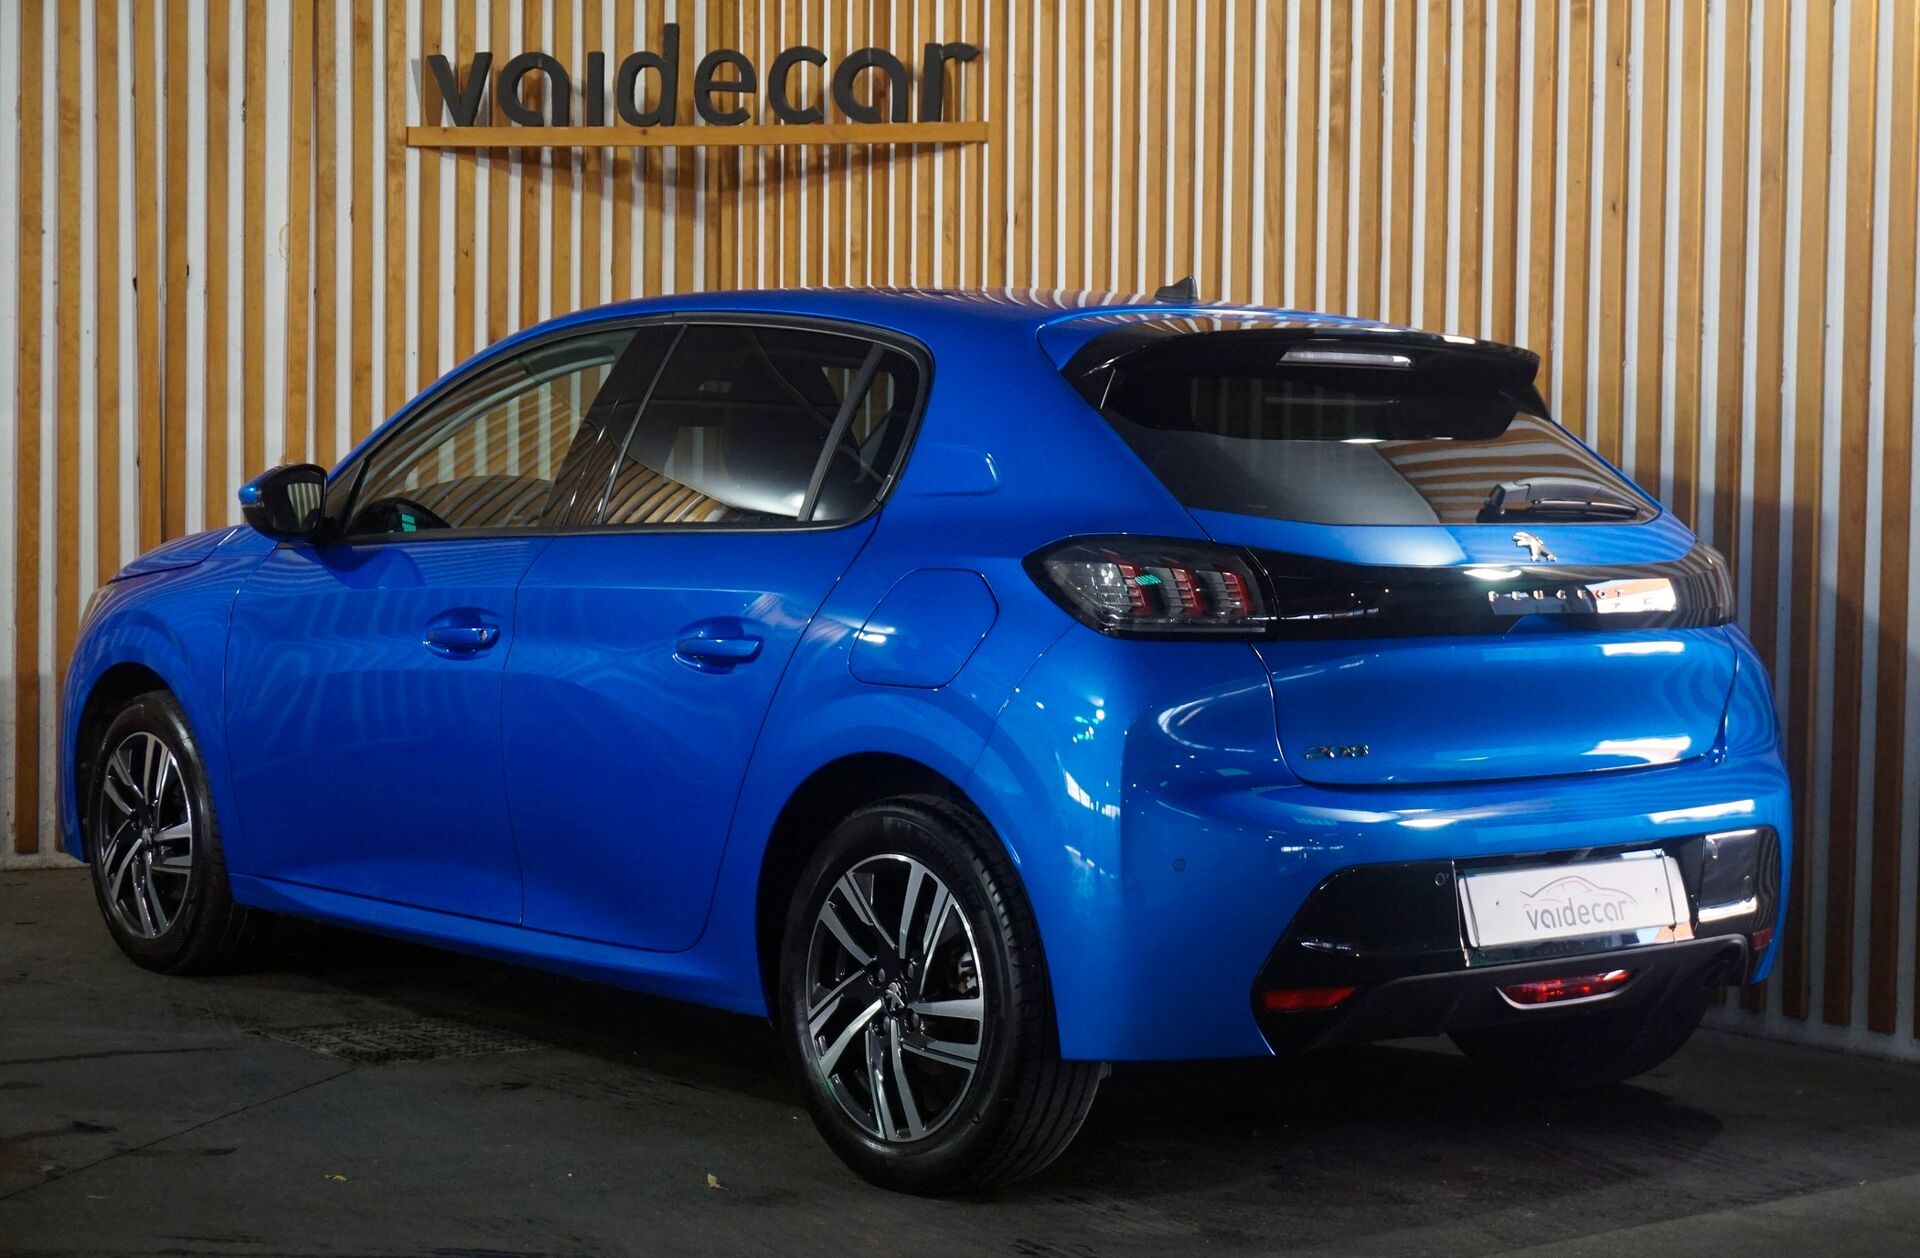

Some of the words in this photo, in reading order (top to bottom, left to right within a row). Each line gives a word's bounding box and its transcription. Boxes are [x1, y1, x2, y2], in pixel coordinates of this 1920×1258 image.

[427, 23, 979, 127] vaidecar
[1304, 744, 1369, 760] 208
[1525, 898, 1627, 931] vaidecar
